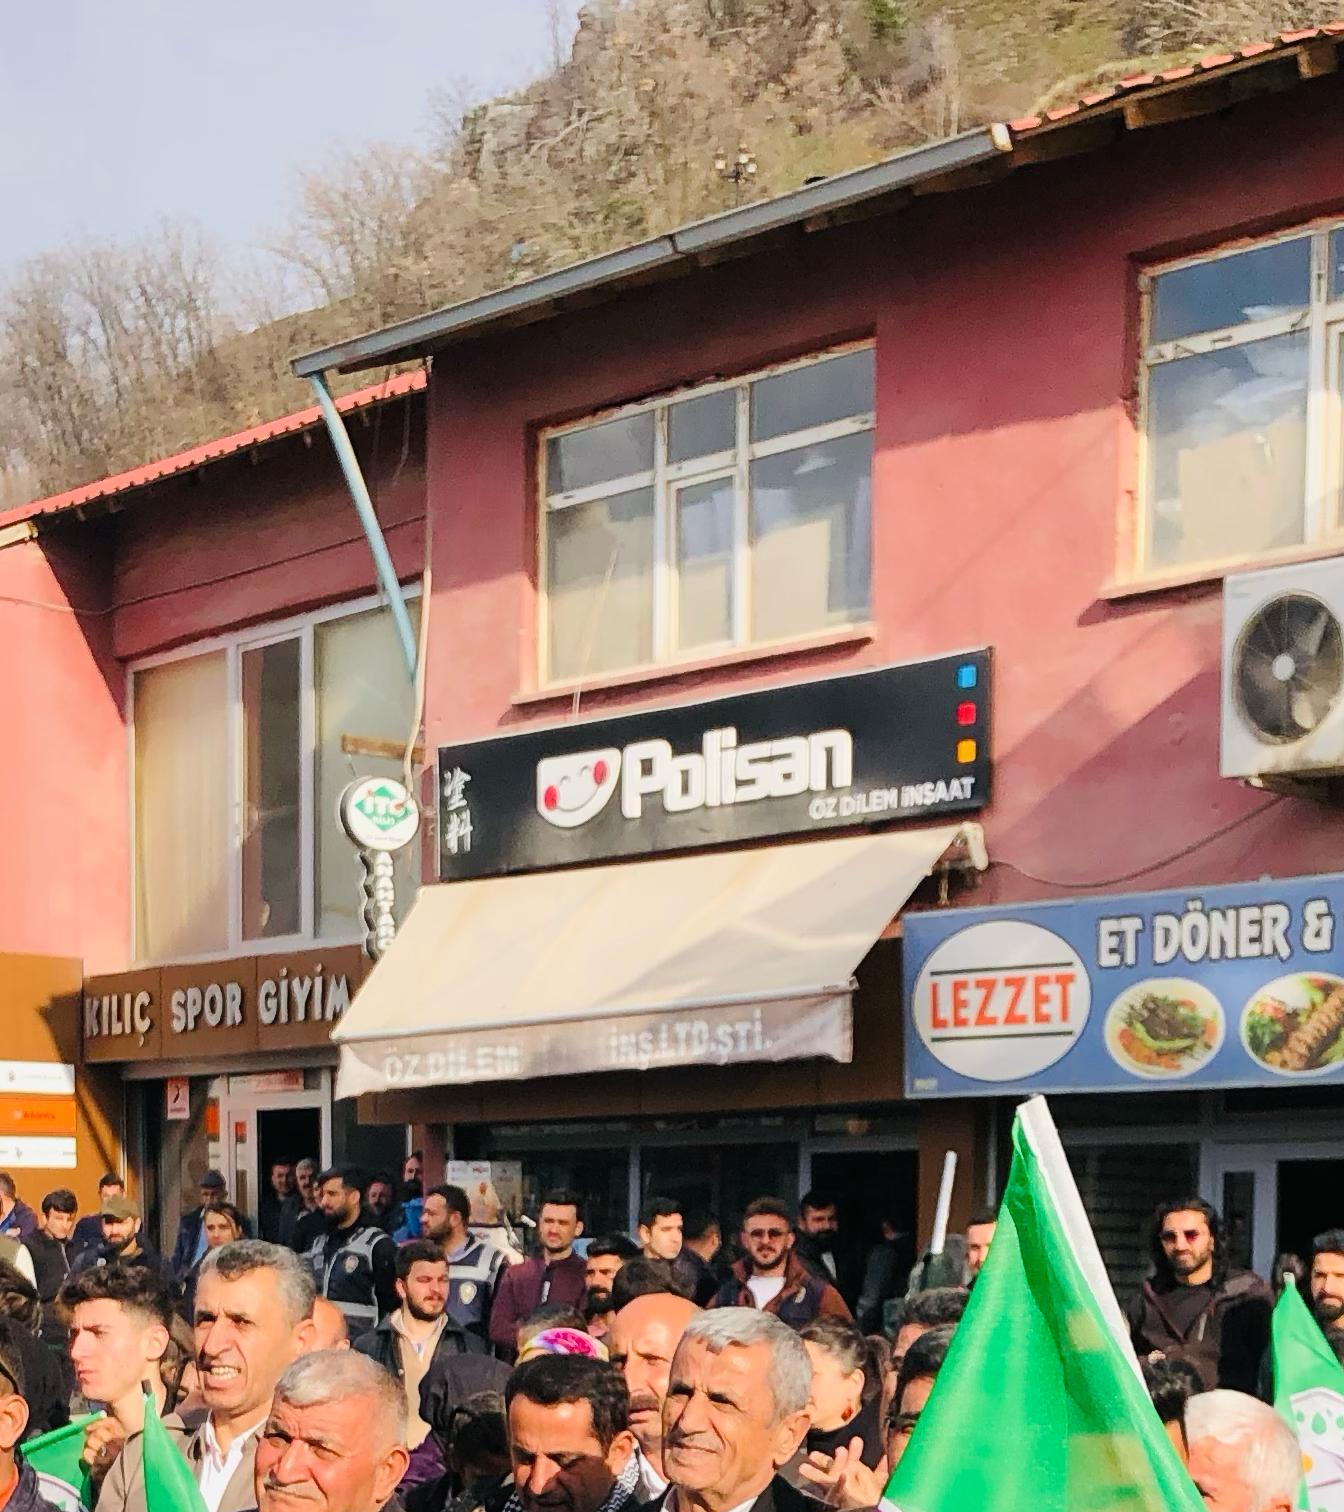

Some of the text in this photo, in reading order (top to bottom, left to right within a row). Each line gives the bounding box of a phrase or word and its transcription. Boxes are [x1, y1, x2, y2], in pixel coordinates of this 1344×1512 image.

[620, 725, 853, 819] Polisan
[1097, 914, 1147, 970] ET
[1152, 898, 1293, 966] DÖNER
[1302, 908, 1336, 955] &
[84, 963, 350, 1048] KILIÇ SPOR GİYİM
[929, 973, 1076, 1030] LEZZET
